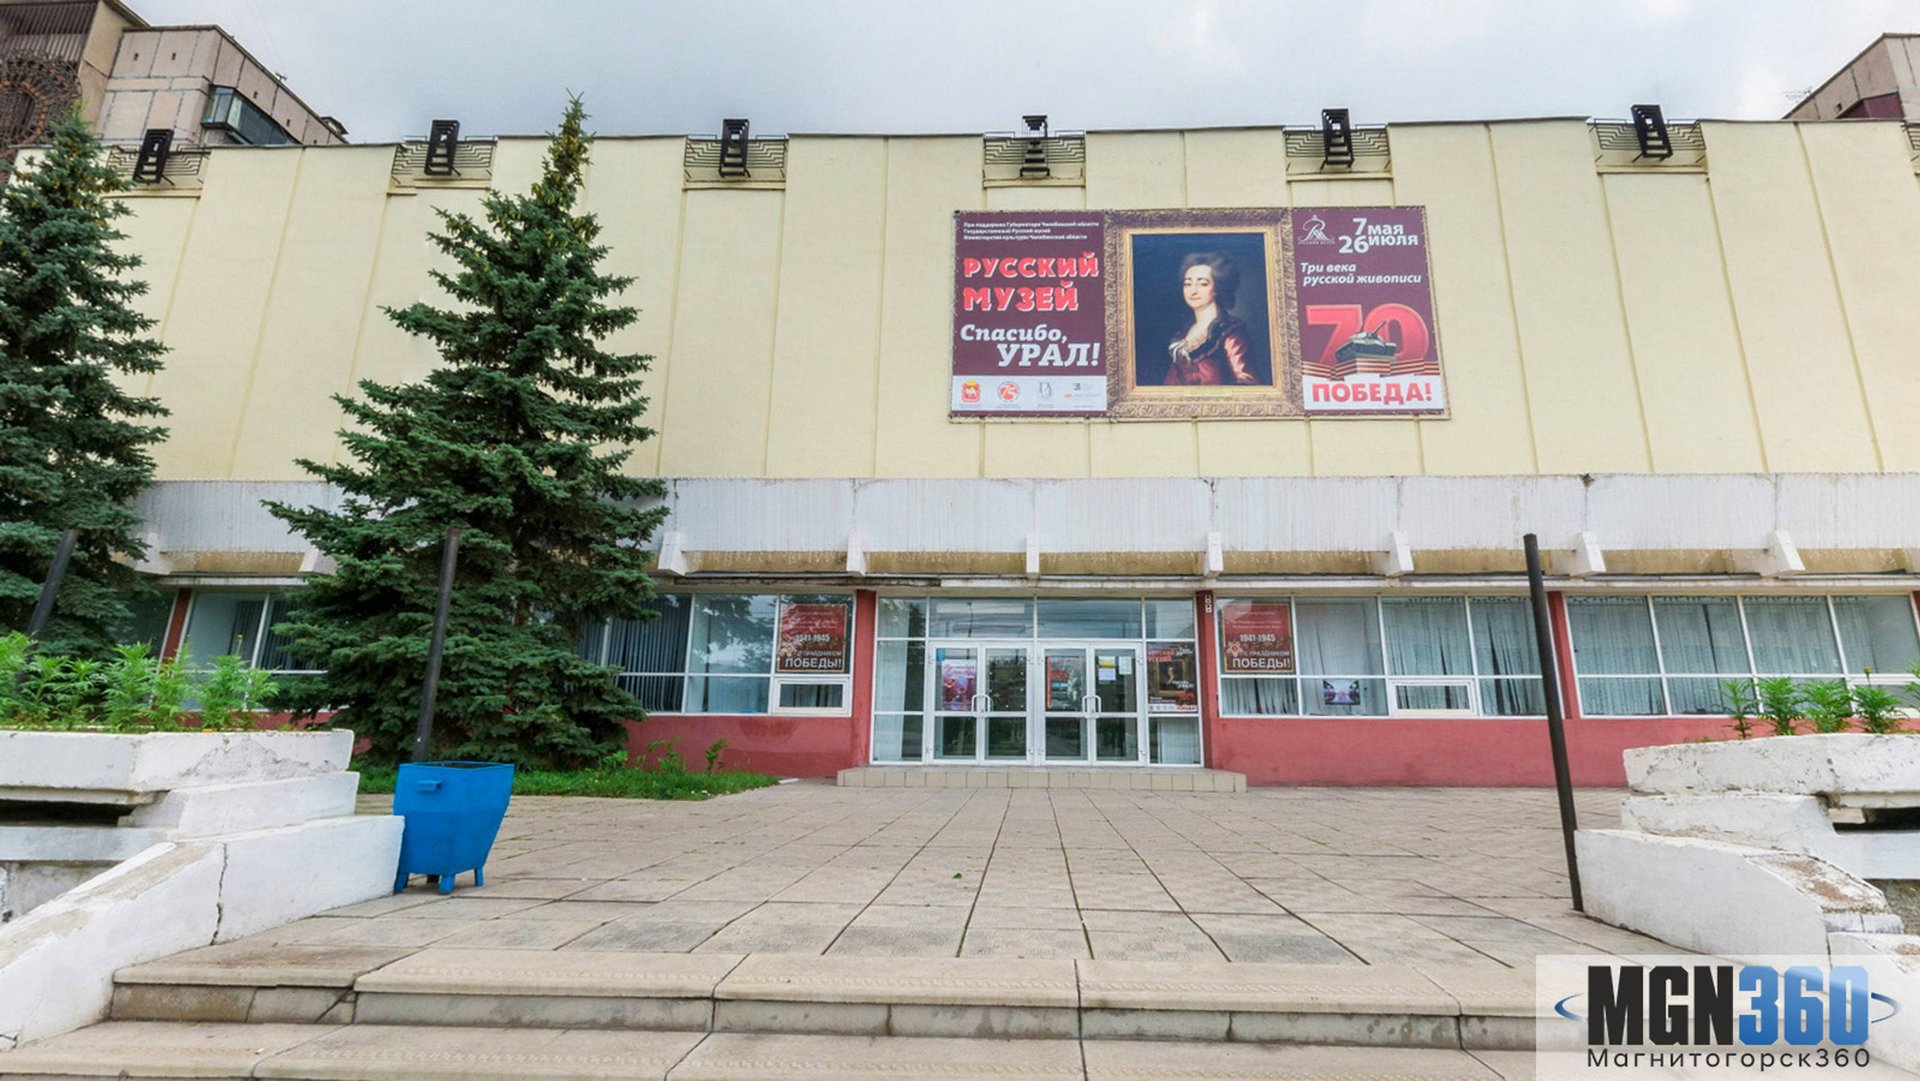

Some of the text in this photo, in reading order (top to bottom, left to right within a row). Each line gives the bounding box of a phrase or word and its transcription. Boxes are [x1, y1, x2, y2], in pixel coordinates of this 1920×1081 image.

[1353, 217, 1404, 236] 7 мая
[1338, 235, 1419, 254] 26 июля
[963, 251, 1100, 278] РУССКИЙ
[1300, 262, 1357, 275] Три века
[1303, 273, 1422, 287] русской живописи
[963, 280, 1079, 312] МУЗЕЙ
[960, 323, 1068, 344] Спасибо,
[1305, 303, 1429, 367] 70
[997, 342, 1101, 367] УРАЛ!
[1312, 382, 1433, 405] ПОБЕДА!
[1239, 633, 1276, 642] 1941-1945
[785, 657, 842, 669] ПОБЕДЫ!
[1232, 657, 1291, 669] ПОБЕДЫ!
